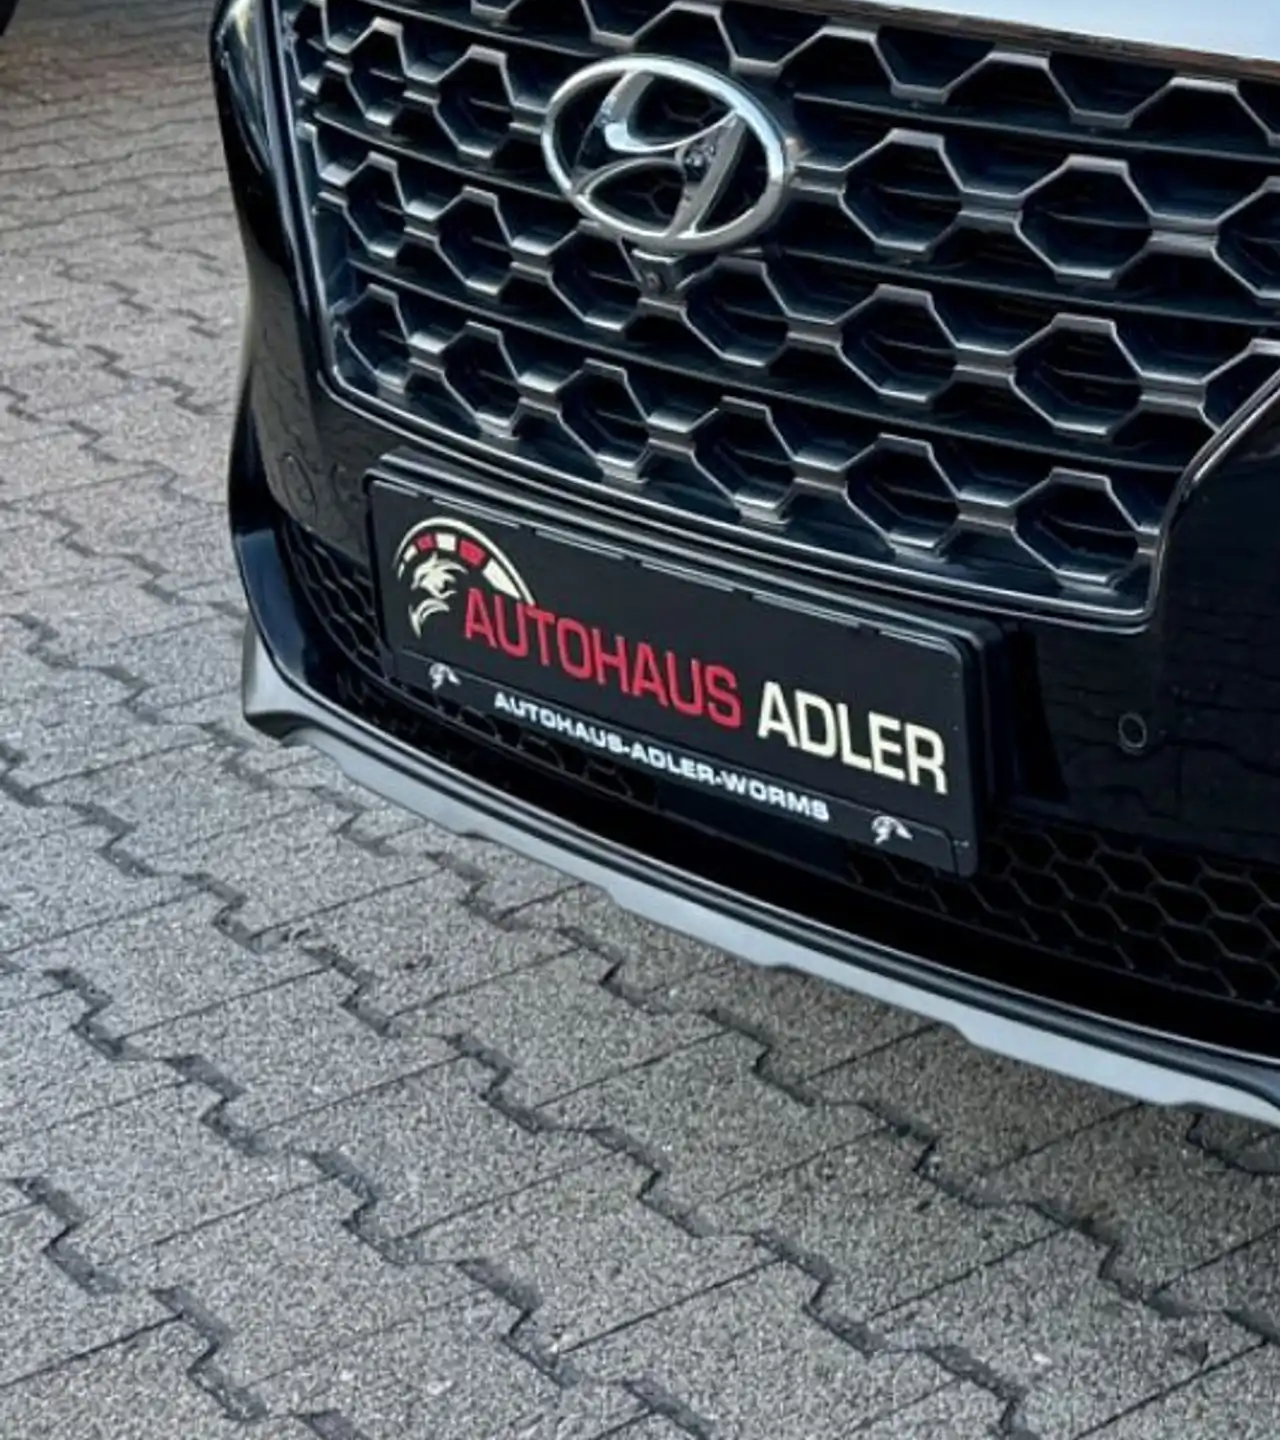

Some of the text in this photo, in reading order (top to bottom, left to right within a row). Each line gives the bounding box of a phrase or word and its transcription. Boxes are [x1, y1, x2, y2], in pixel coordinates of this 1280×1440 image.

[464, 586, 948, 796] AUTOHAUS ADLER
[494, 691, 830, 822] AUTOHAUS-ADLER-WORMS
